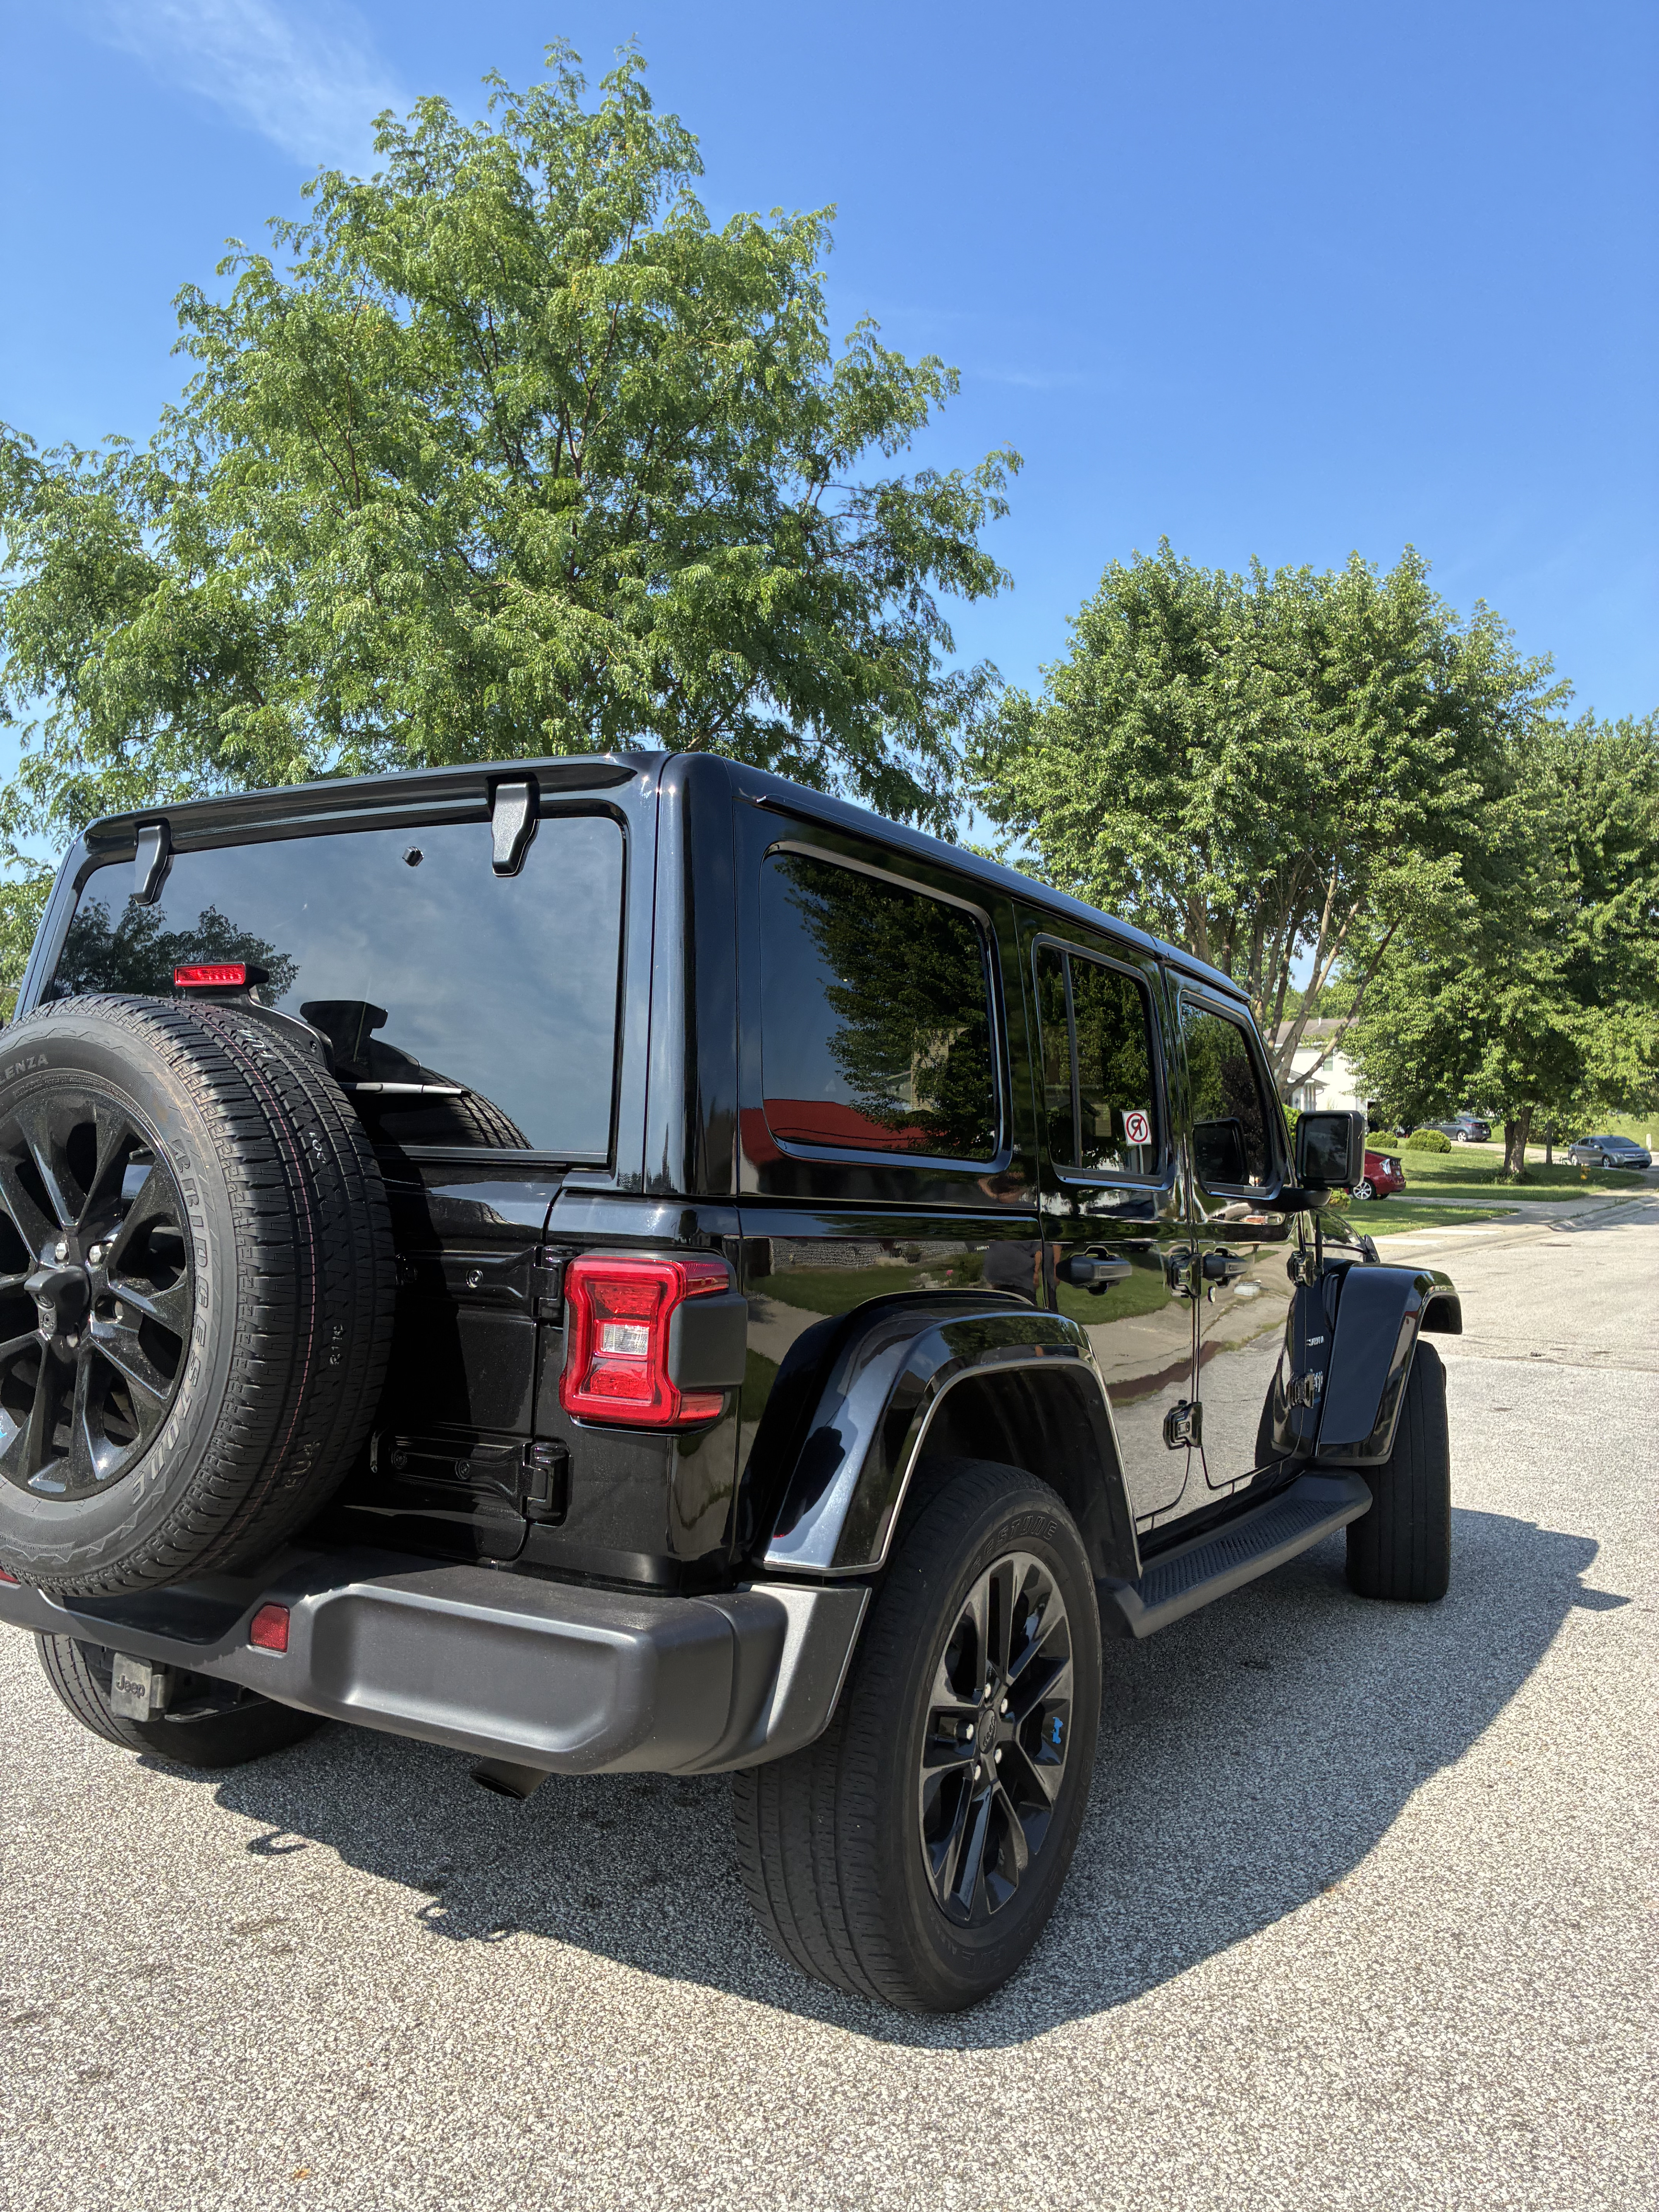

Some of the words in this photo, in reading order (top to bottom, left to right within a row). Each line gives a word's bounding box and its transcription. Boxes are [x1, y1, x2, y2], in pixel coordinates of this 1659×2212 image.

[0, 1054, 48, 1084] ENZA
[132, 1139, 210, 1506] BRIDGESTONE
[116, 1675, 145, 1699] Jeep
